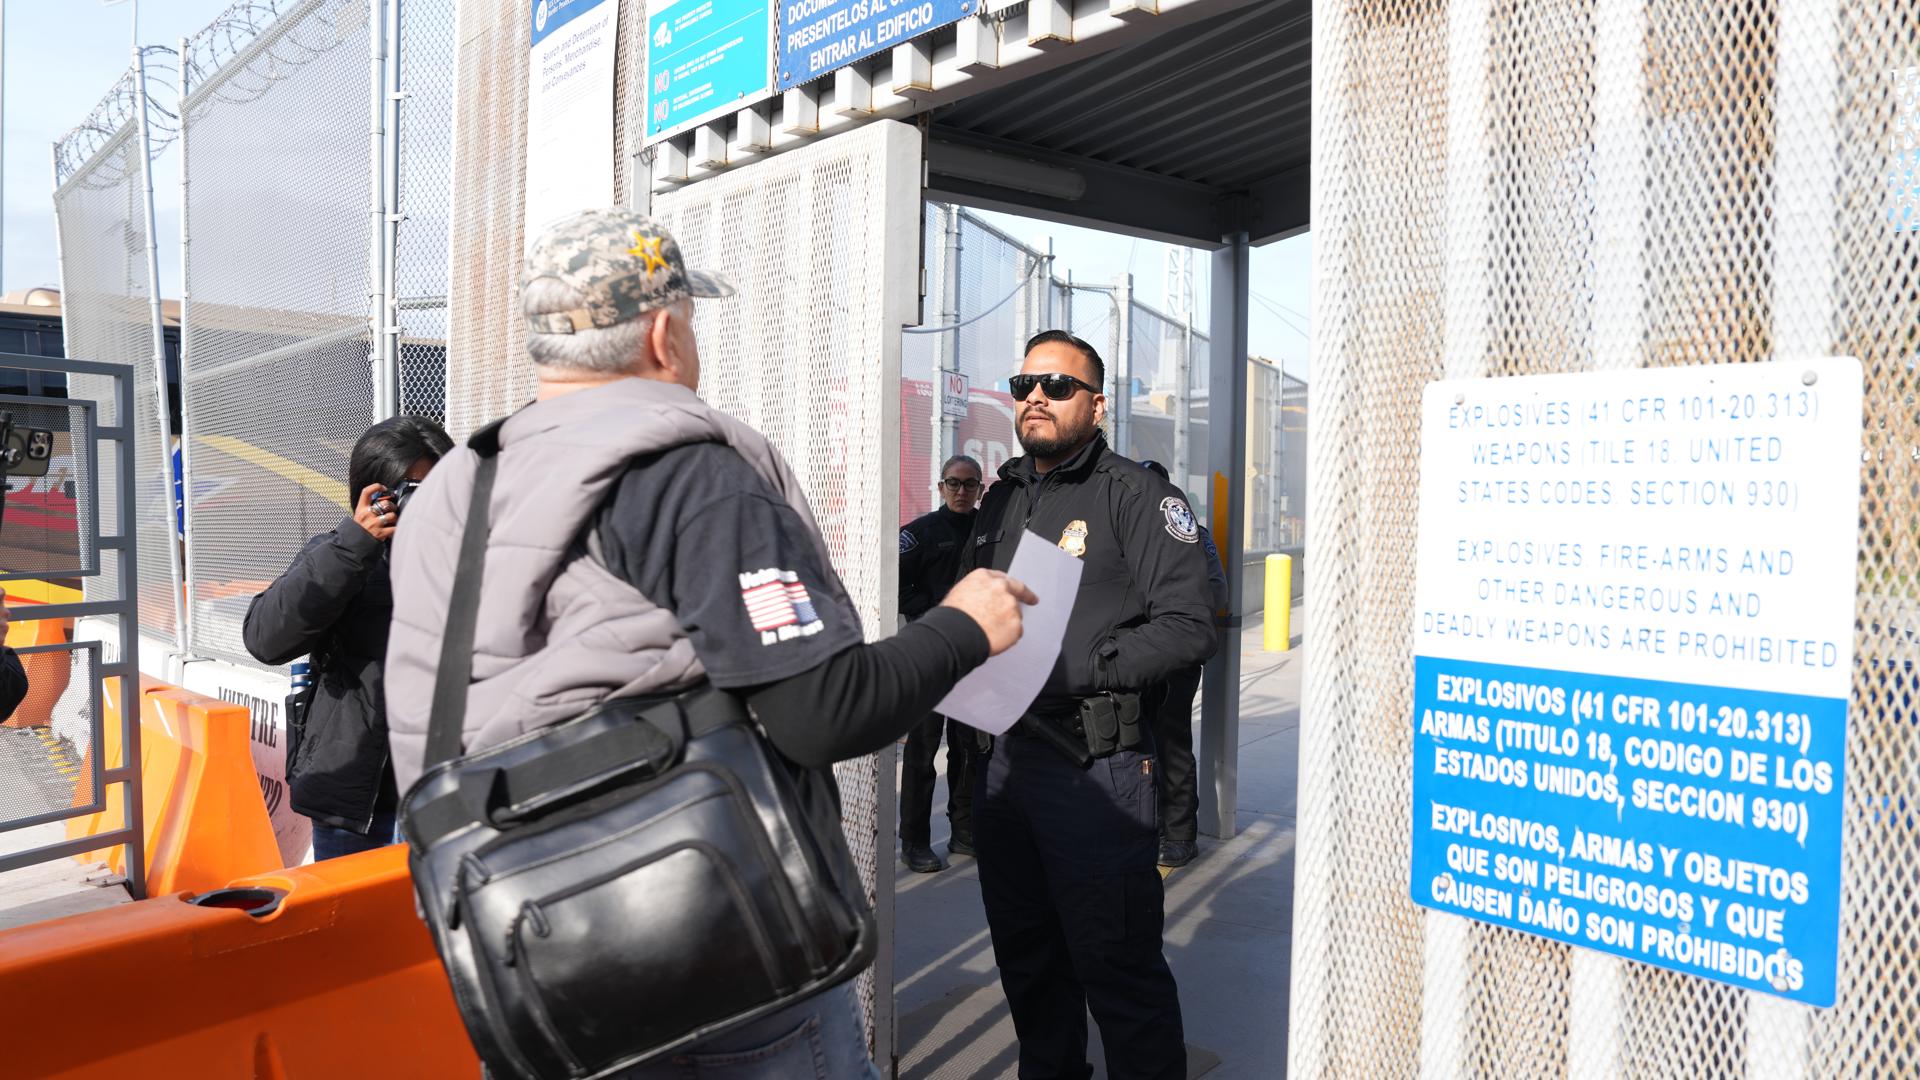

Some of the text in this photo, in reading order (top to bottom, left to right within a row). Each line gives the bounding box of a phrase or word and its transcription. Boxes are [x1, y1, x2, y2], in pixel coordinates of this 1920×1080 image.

[543, 46, 560, 63] Search
[573, 22, 601, 45] Detention
[788, 0, 868, 53] PRESENTELOS
[810, 2, 933, 72] ENTRAR AL EDIFICIO
[654, 69, 670, 96] NO
[654, 99, 669, 124] NO
[950, 375, 963, 394] NO
[1449, 402, 1570, 429] EXPLOSIVES
[1622, 396, 1667, 423] CFR
[1472, 441, 1570, 466] WEAPONS
[1689, 436, 1783, 463] UNITED
[1457, 481, 1531, 504] STATES
[1630, 480, 1735, 506] SECTION
[1600, 545, 1729, 574] FIRE-ARMS
[1740, 550, 1794, 577] AND
[1478, 578, 1761, 619] OTHER DANGEROUS AND
[1423, 612, 1837, 668] DEADLY WEAPONS ARE PROHIBITED
[1437, 674, 1811, 753] EXPLOSIVOS (41 CFR 101-20.313)
[1420, 709, 1833, 794] ARMAS (TITULO 18, CODIGO DE LOS
[1435, 746, 1809, 845] ESTADOS UNIDOS, SECCION 930)
[1431, 801, 1809, 905] EXPLOSIVOS, ARMAS Y OBJETOS
[1446, 843, 1785, 943] QUE SON PELIGROSOS Y QUE
[1431, 876, 1804, 991] CAUSEN DAÑO SON PROHIBIDOS
